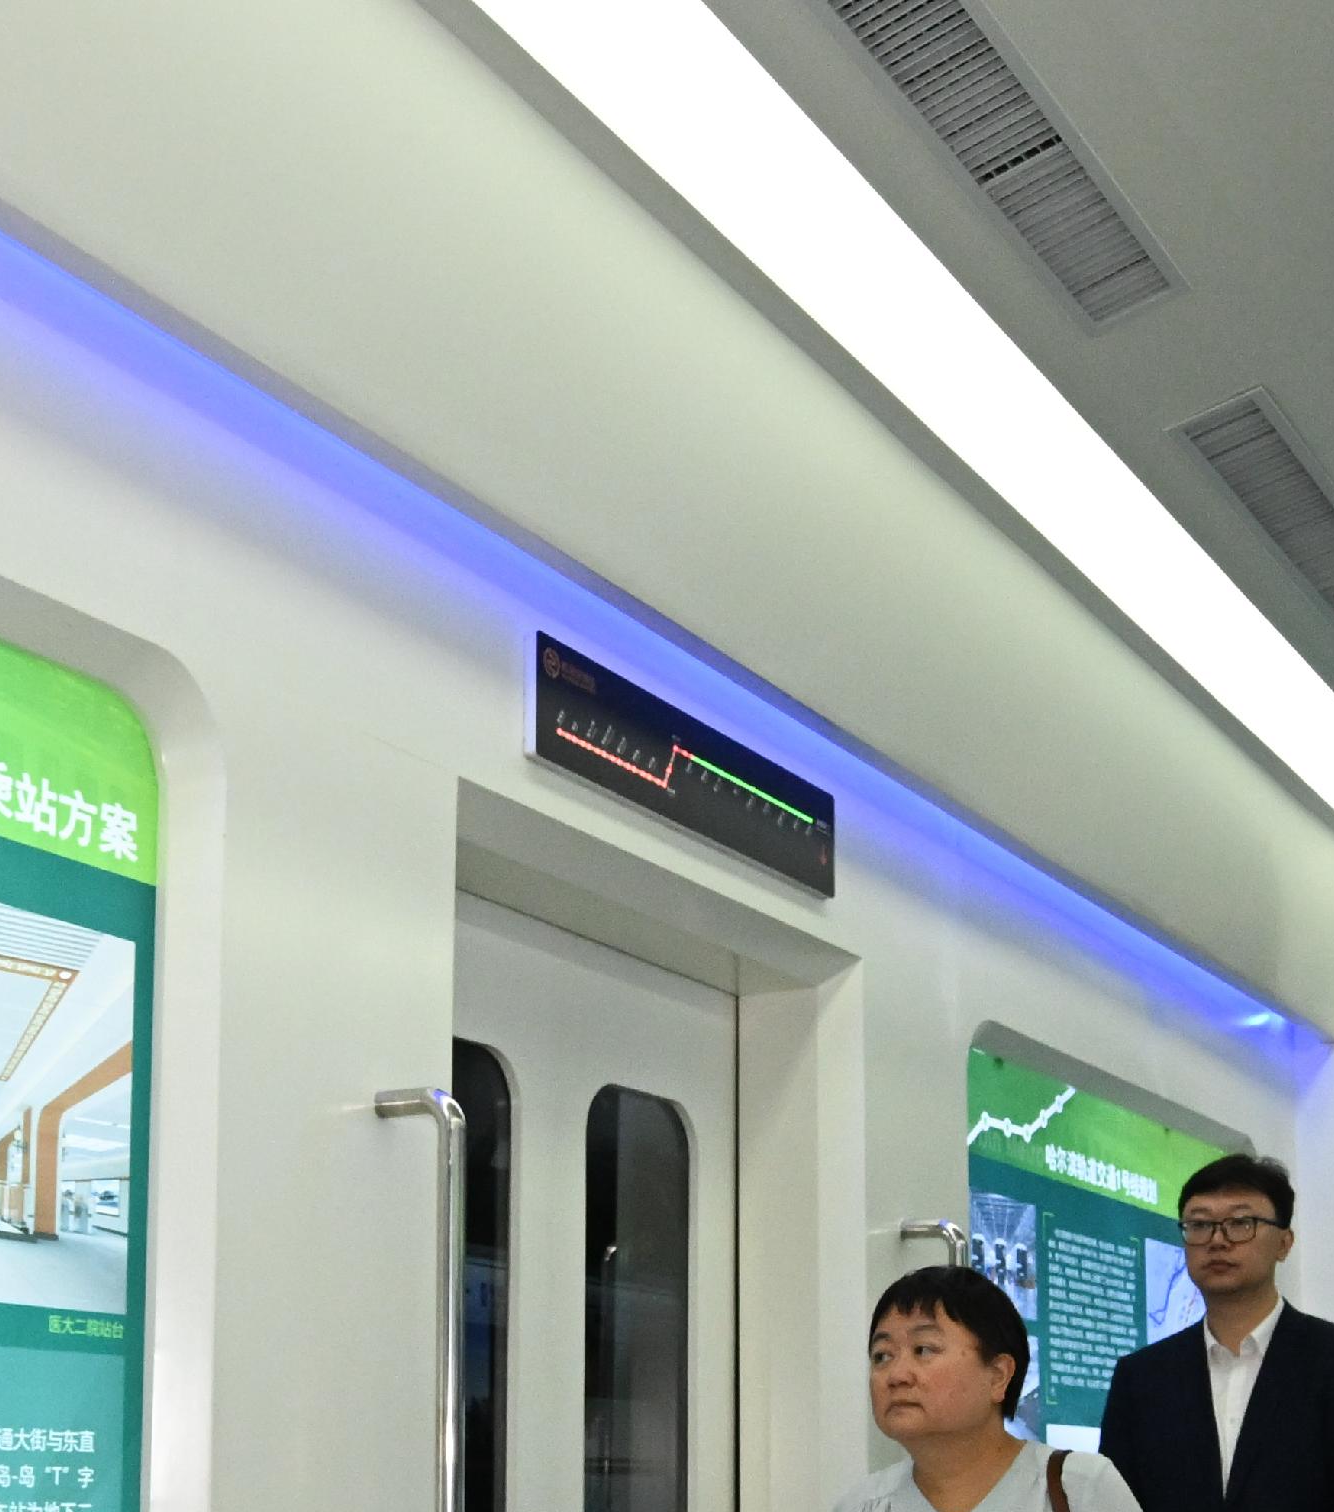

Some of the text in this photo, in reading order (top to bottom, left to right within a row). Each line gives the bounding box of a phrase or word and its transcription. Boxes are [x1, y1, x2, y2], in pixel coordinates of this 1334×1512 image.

[48, 1314, 124, 1340] 医大二院站台
